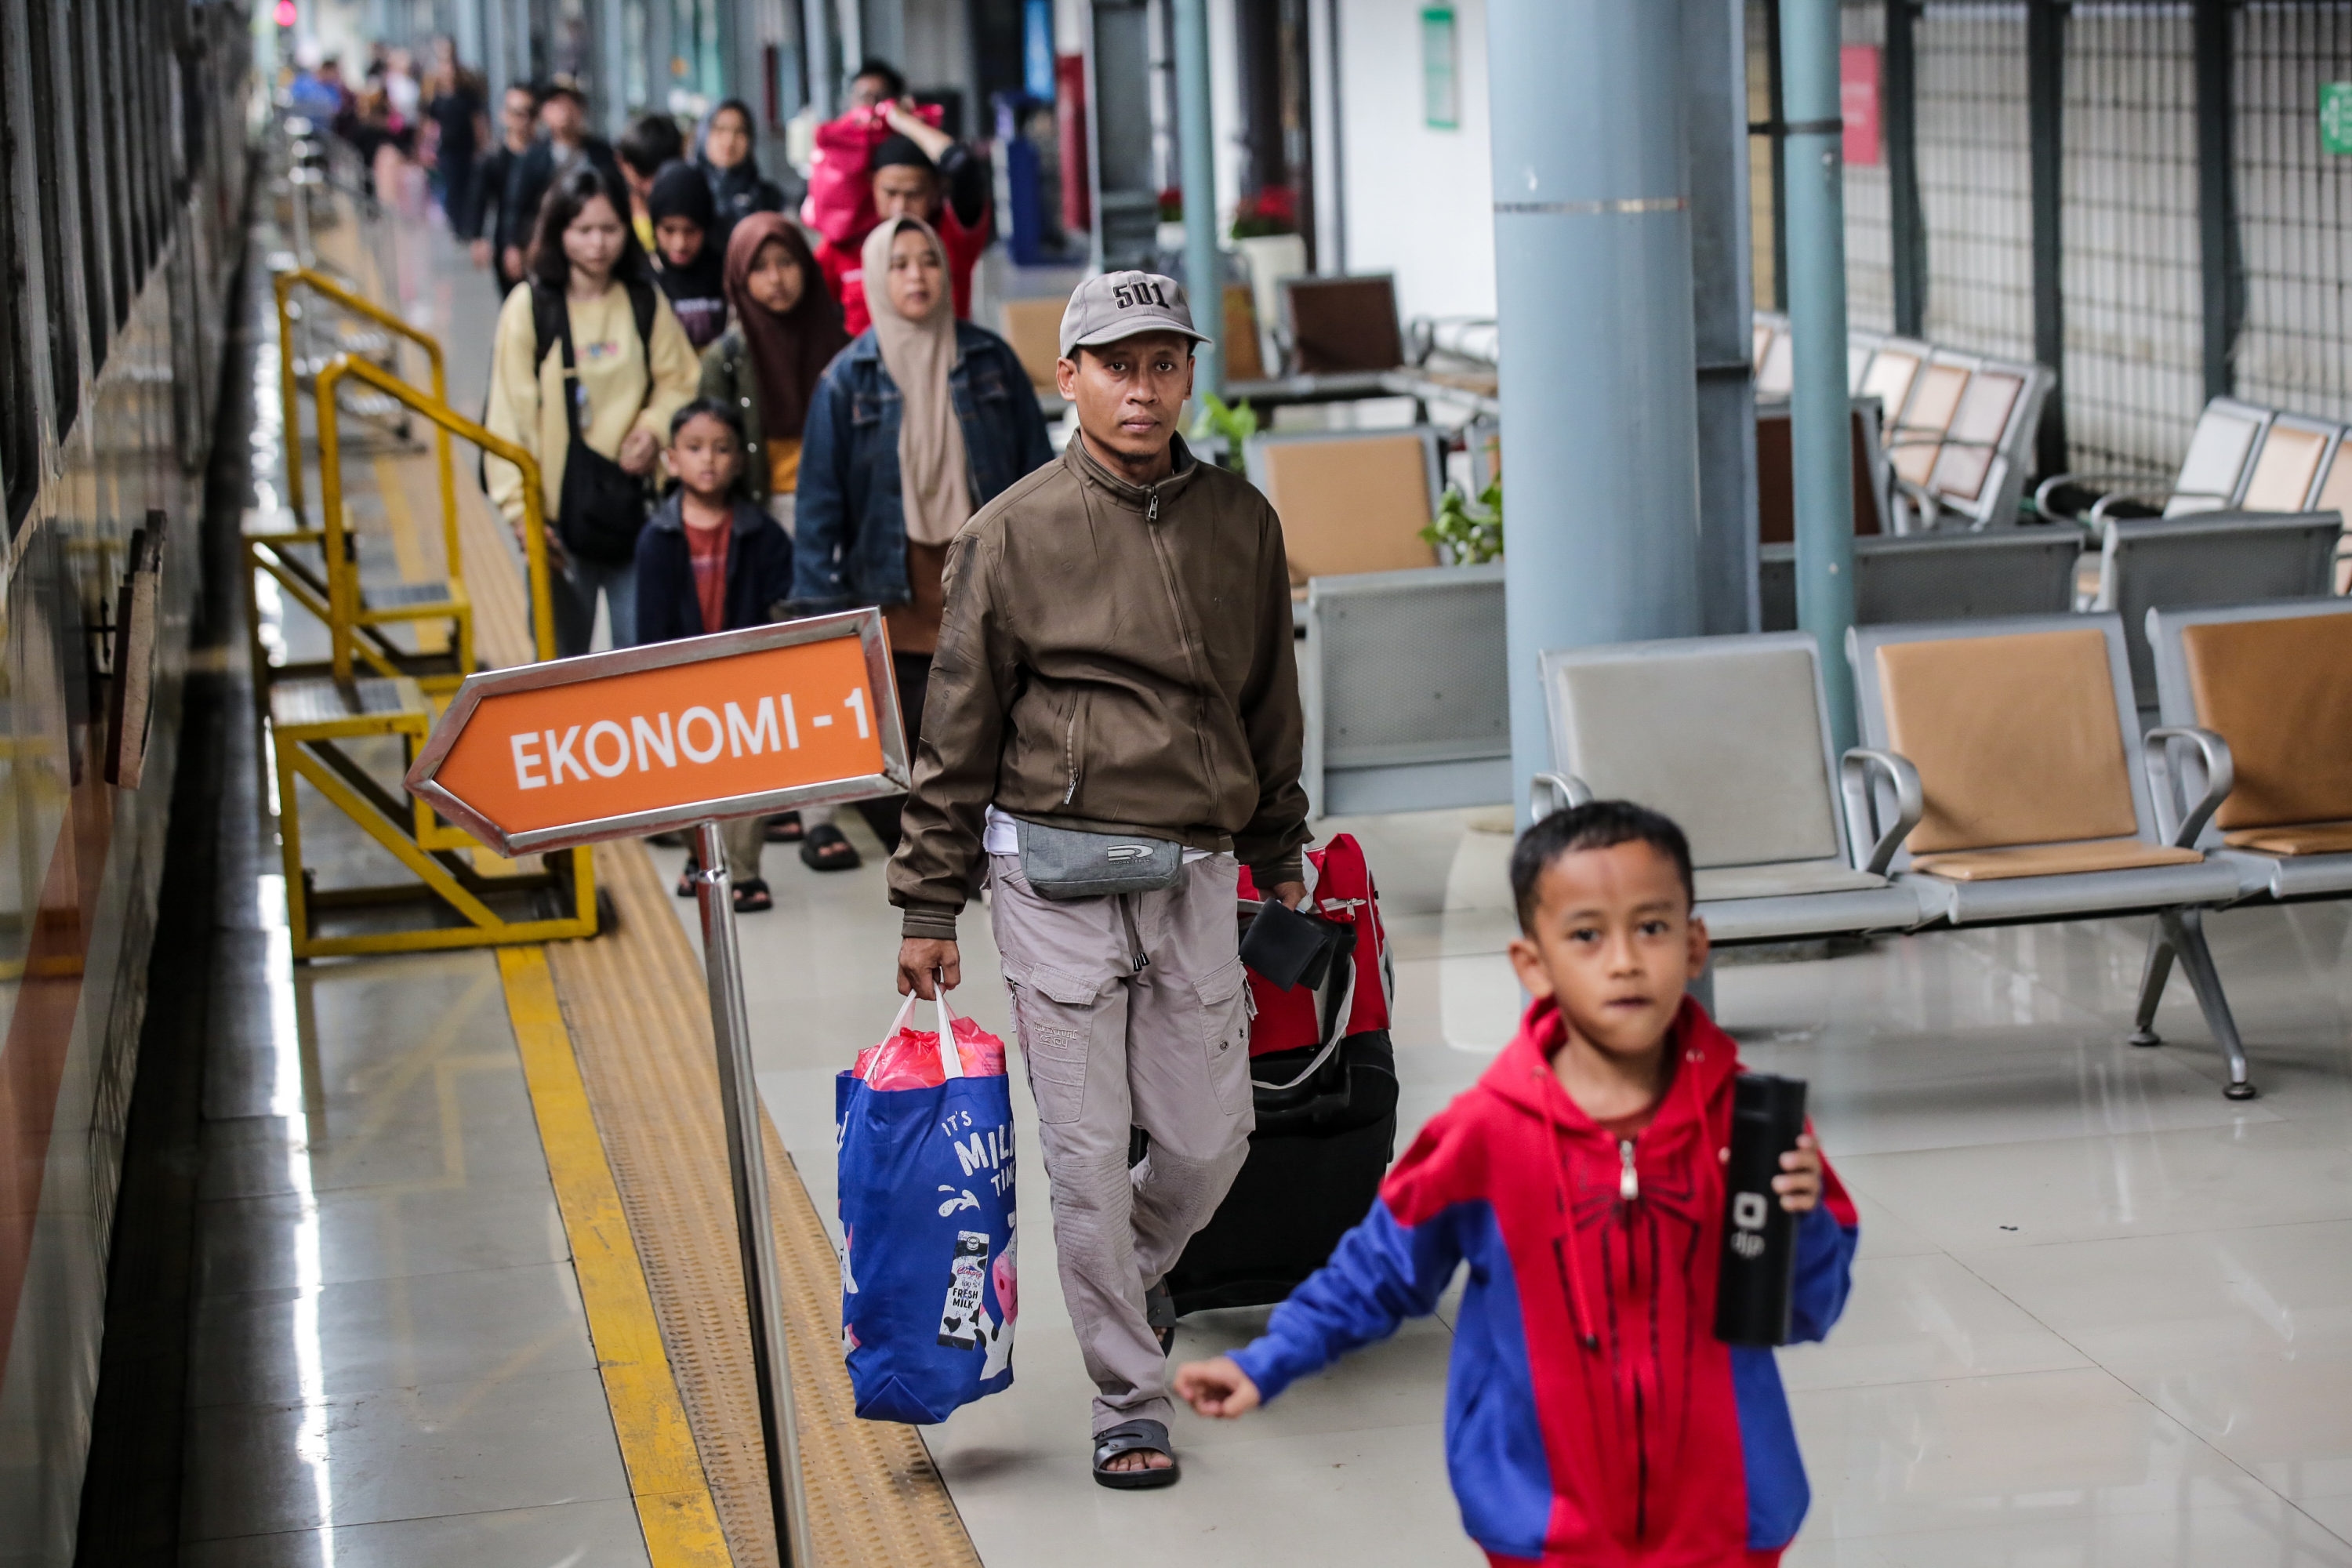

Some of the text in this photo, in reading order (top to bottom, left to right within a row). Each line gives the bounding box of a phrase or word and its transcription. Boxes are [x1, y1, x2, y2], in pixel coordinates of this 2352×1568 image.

[1112, 281, 1171, 310] 501
[510, 687, 869, 790] EKONOMI - 1
[942, 1110, 972, 1137] IT'S
[952, 1287, 978, 1300] FRESH
[952, 1298, 974, 1309] MILK
